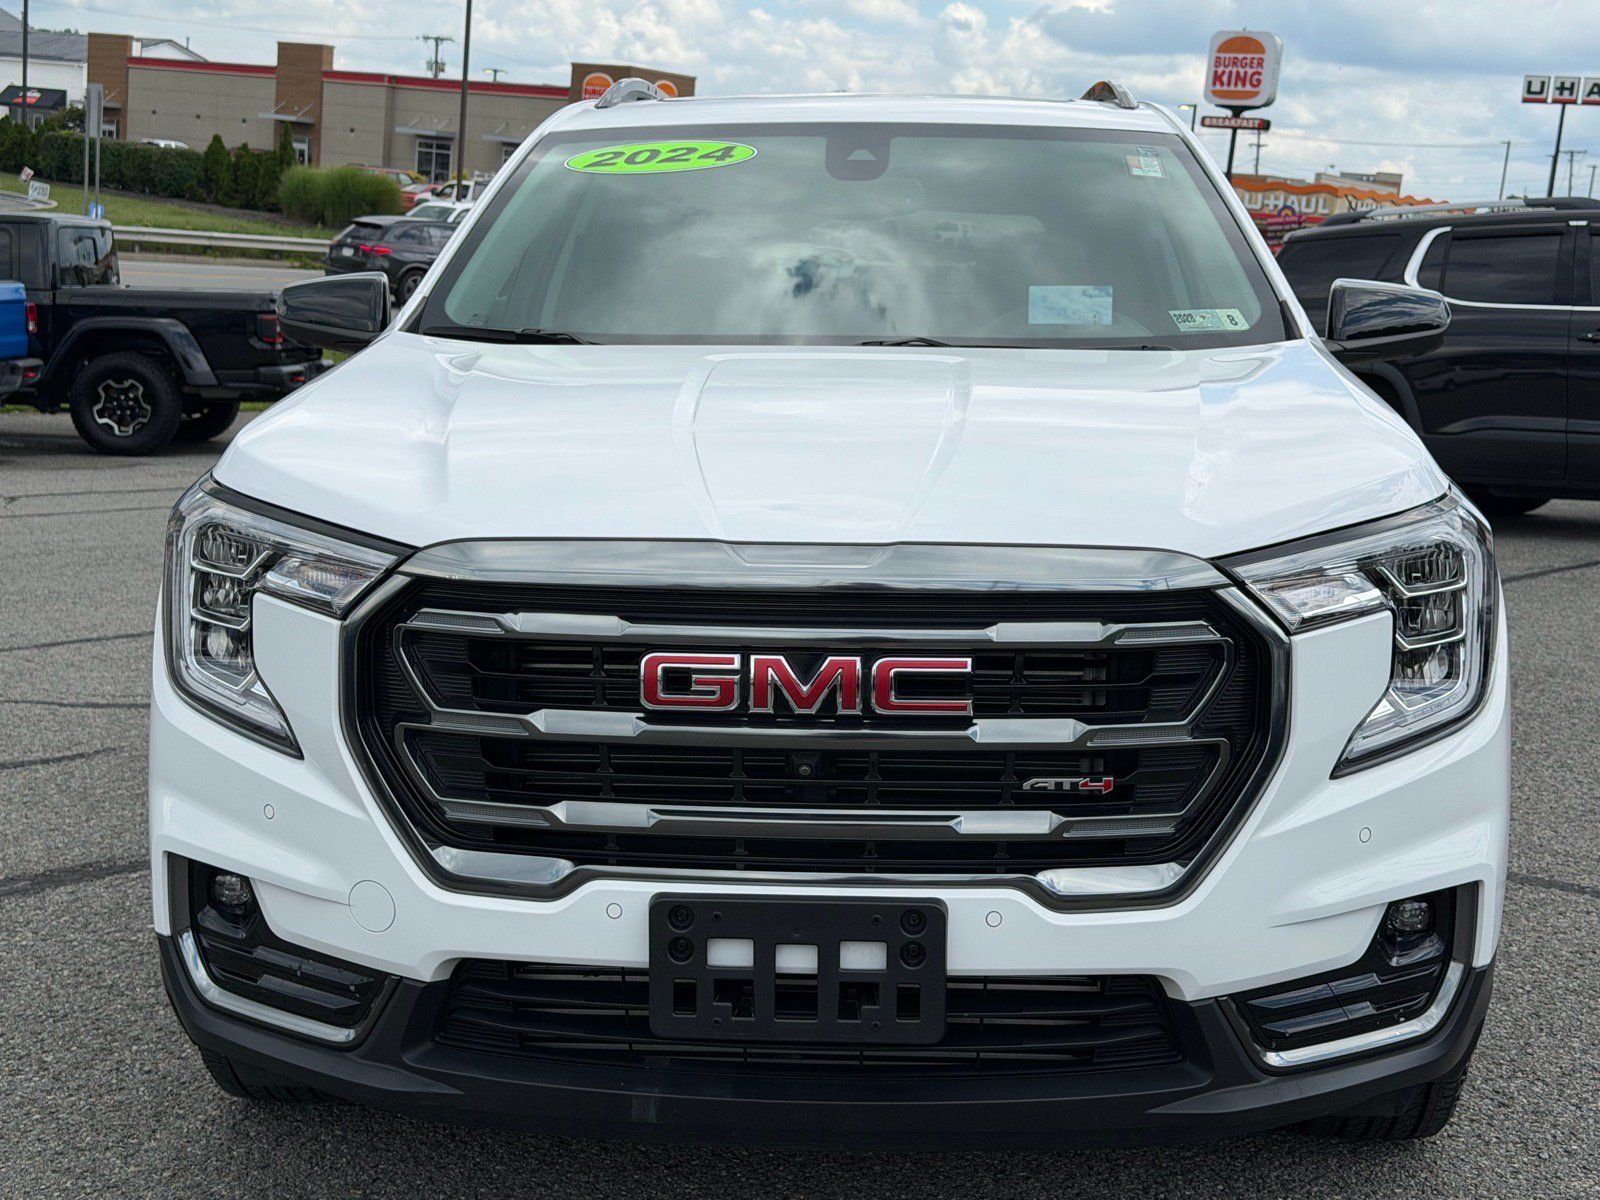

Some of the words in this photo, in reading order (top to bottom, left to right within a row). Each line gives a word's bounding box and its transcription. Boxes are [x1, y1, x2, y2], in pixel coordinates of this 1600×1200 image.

[1214, 56, 1264, 68] BURGER
[1212, 70, 1263, 88] KING
[582, 145, 738, 168] 2024
[1226, 314, 1239, 326] 8
[640, 652, 973, 716] GMC
[1023, 777, 1113, 795] AT4
